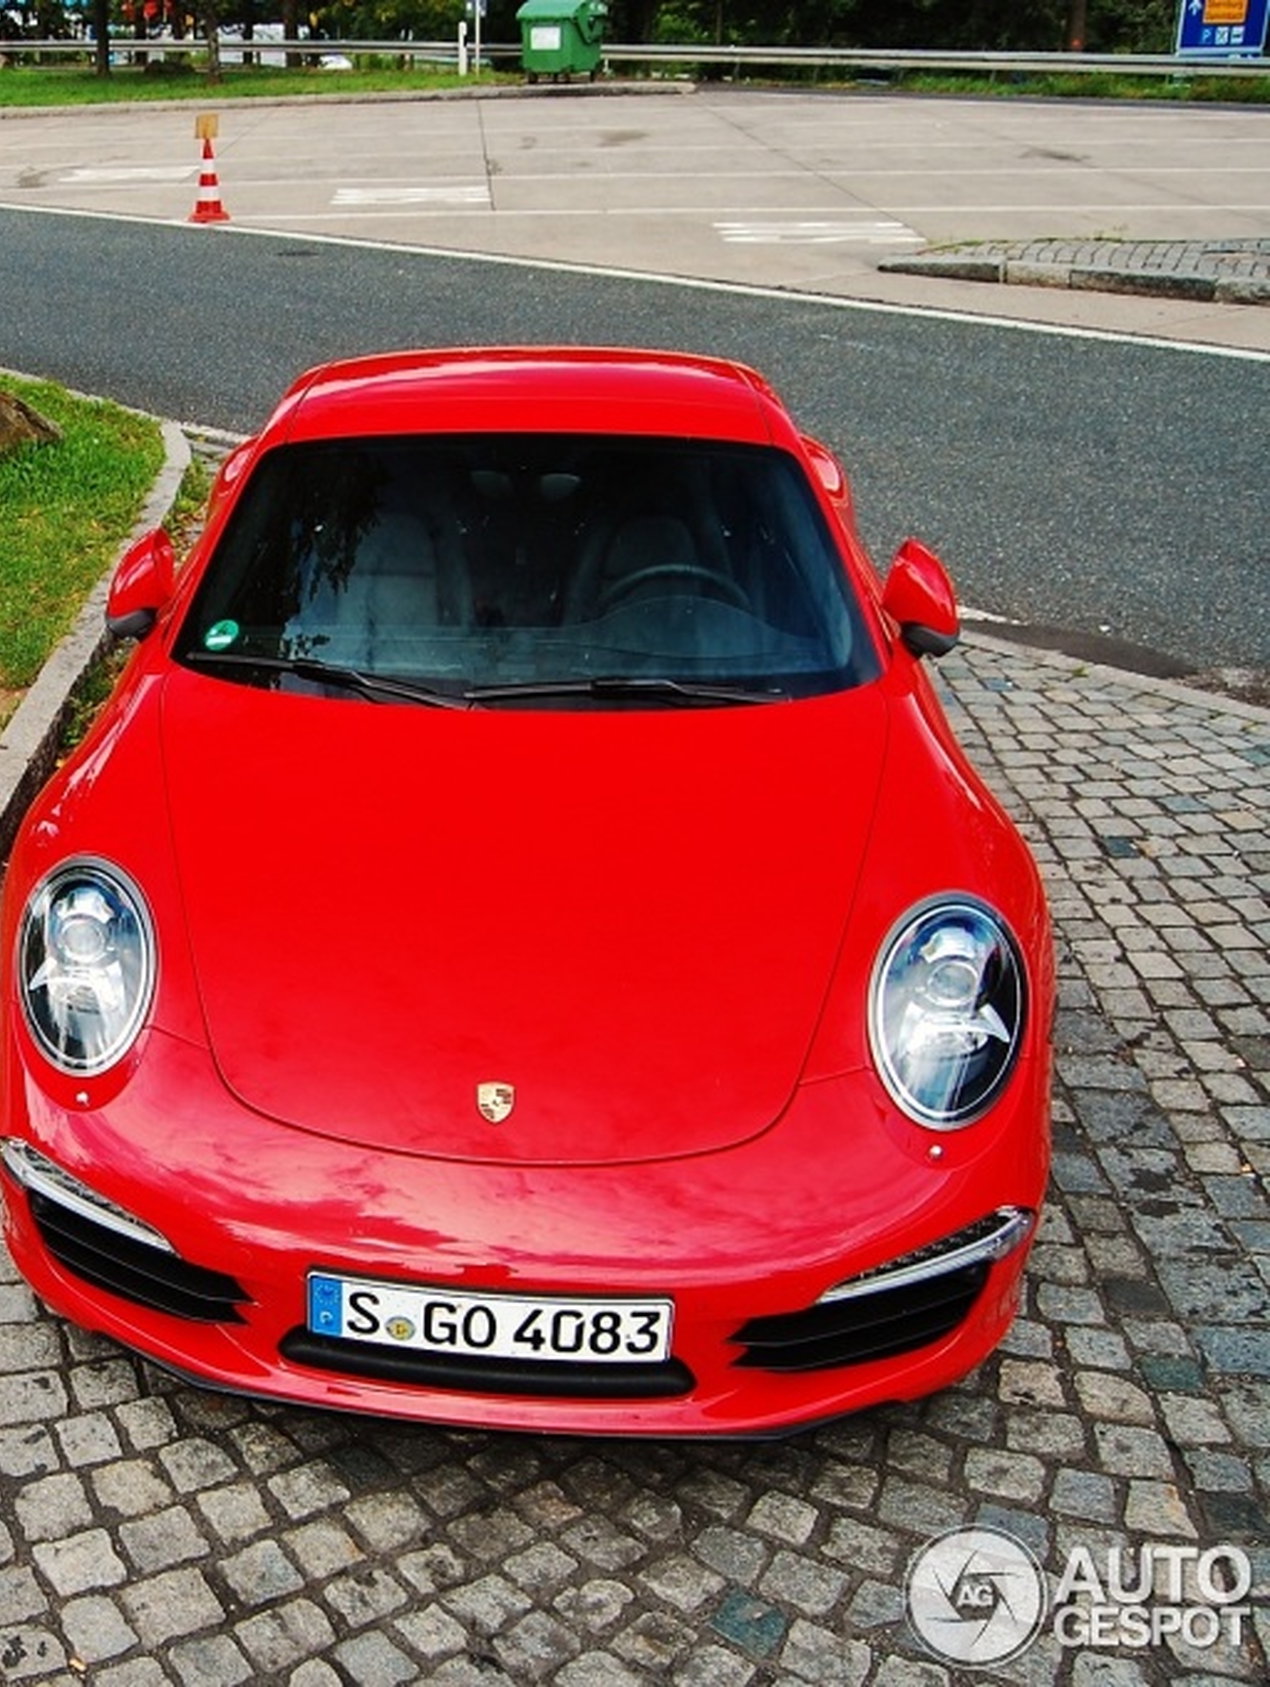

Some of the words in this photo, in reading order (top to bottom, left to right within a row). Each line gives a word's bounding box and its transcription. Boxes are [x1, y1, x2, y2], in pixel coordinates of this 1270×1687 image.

[346, 1292, 380, 1335] S
[423, 1302, 497, 1349] GO
[513, 1308, 662, 1356] 4083
